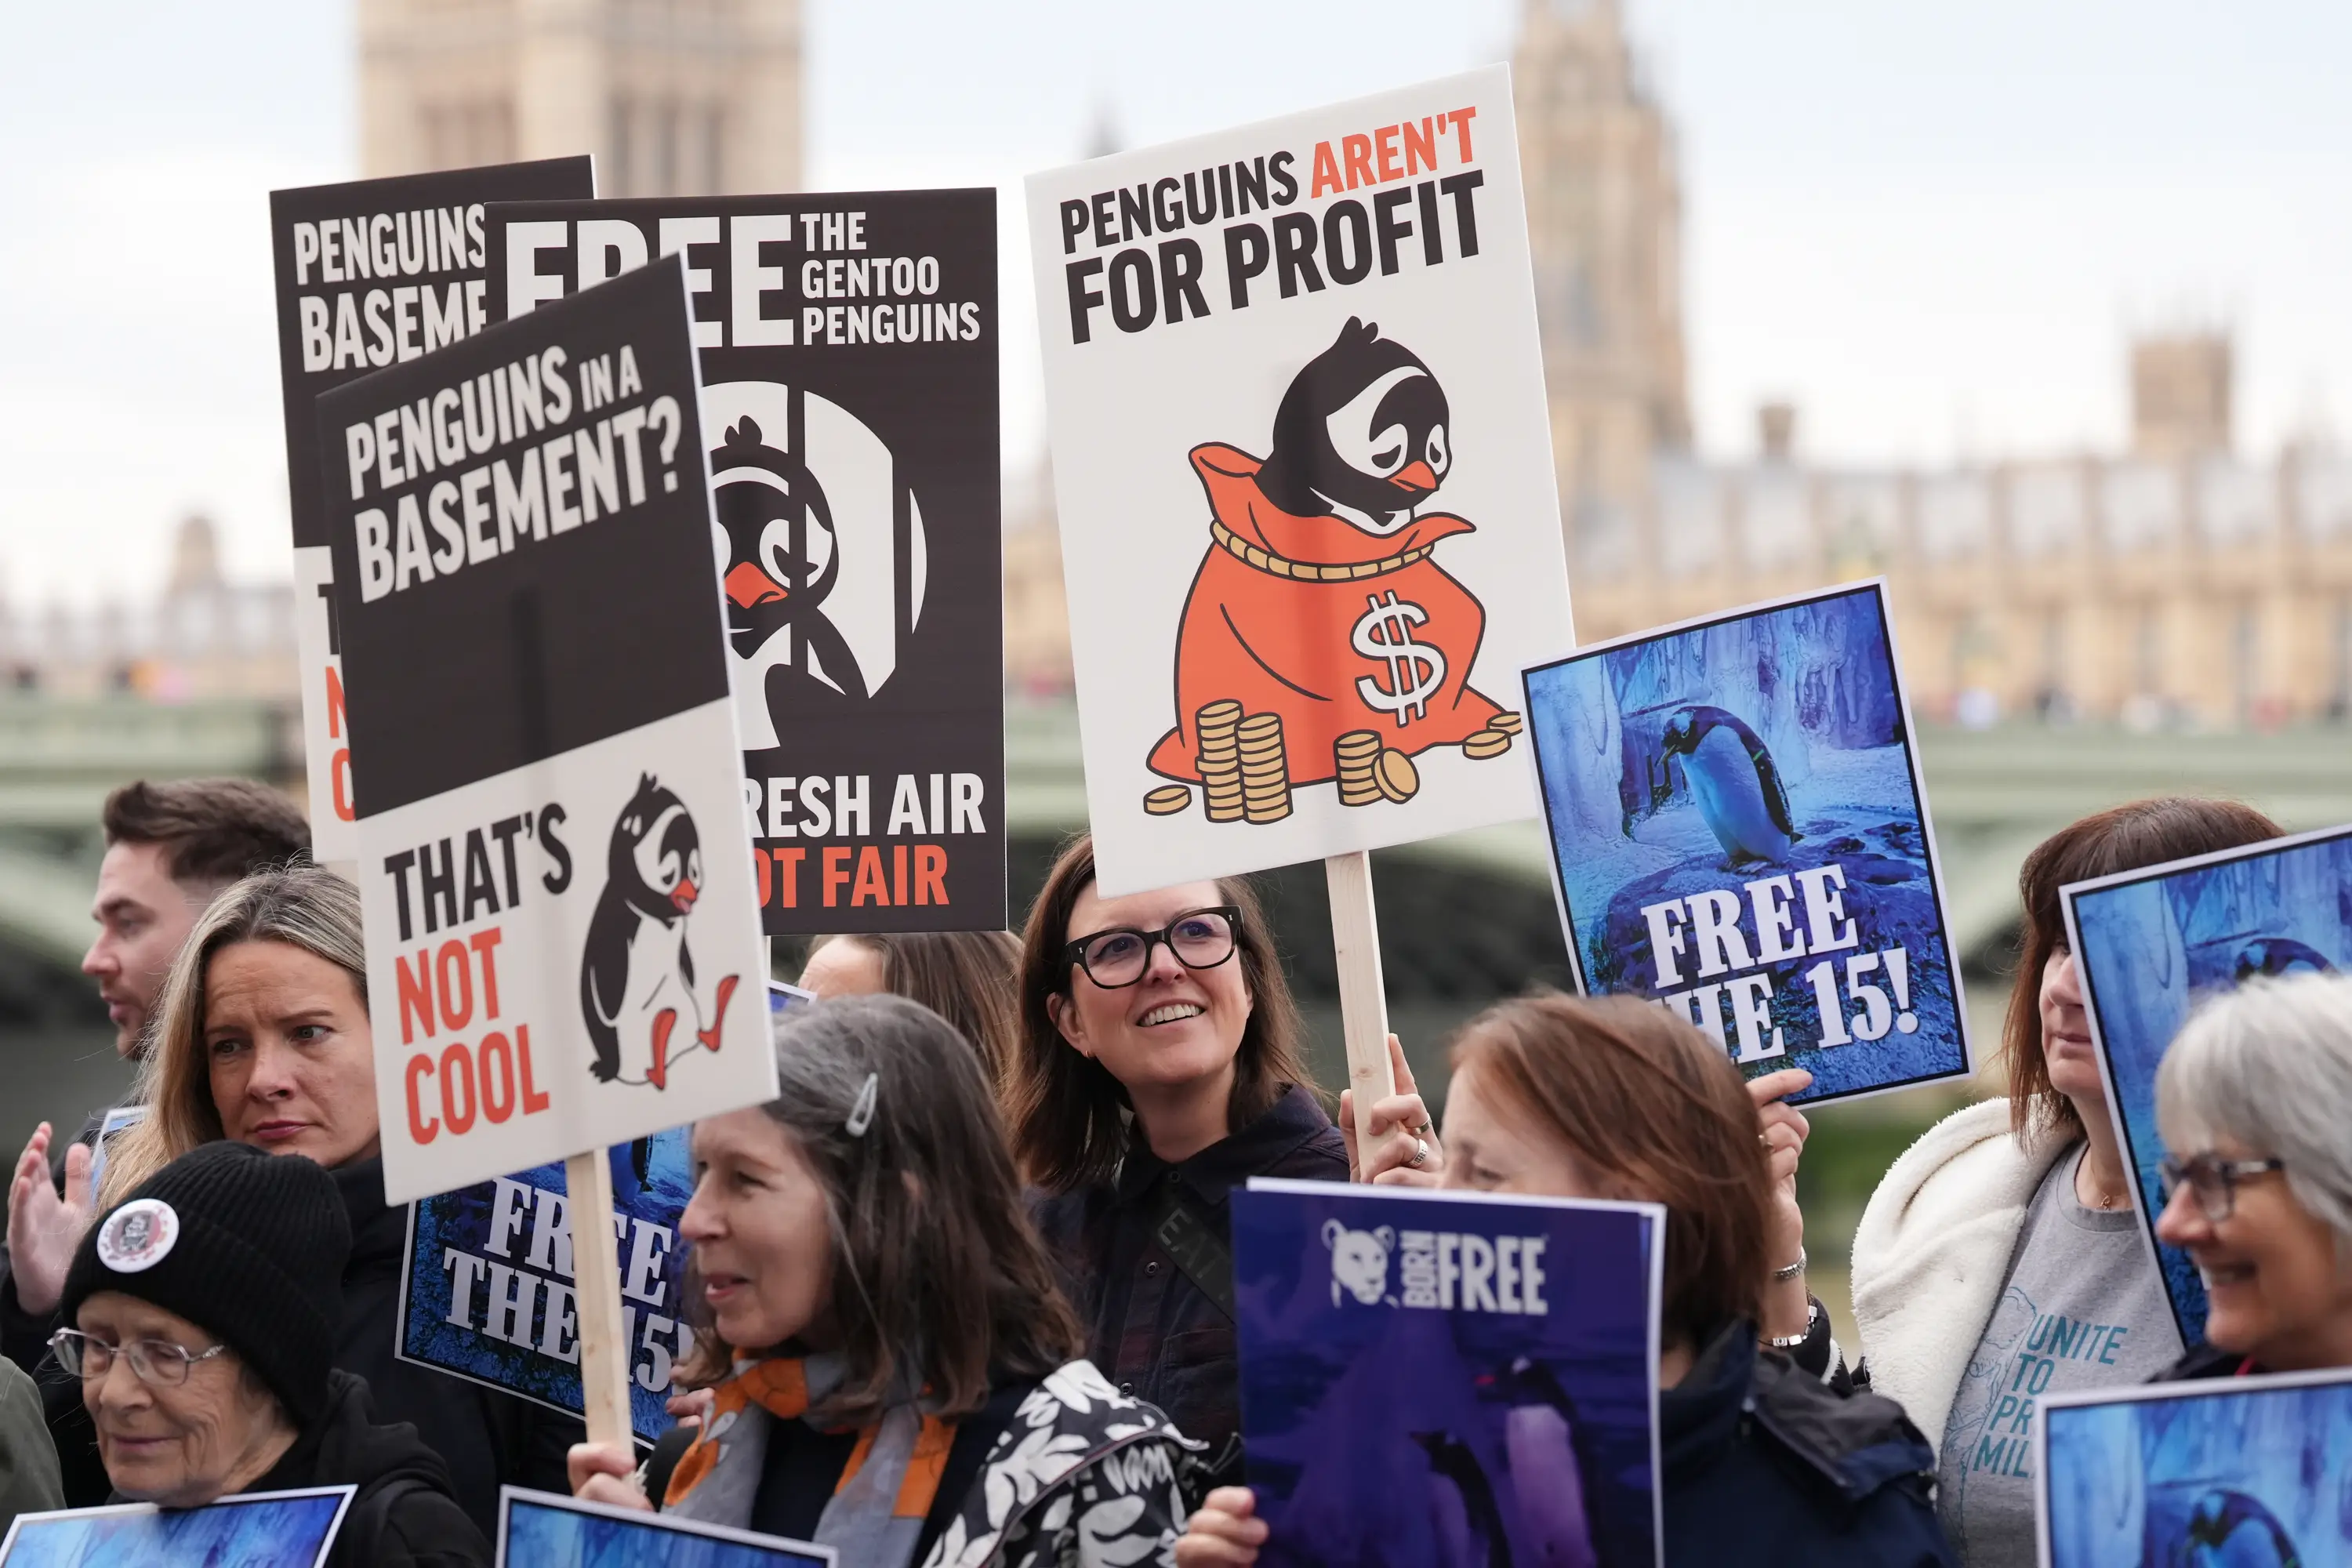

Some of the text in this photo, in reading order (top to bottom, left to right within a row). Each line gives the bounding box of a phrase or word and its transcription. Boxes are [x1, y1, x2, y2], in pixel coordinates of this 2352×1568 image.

[800, 212, 867, 252] THE
[1060, 106, 1477, 254] PENGUINS AREN'T
[293, 204, 485, 285] PENGUINS
[801, 256, 939, 299] GENTOO
[1065, 169, 1484, 345] FOR PROFIT
[803, 302, 981, 345] PENGUINS
[345, 344, 643, 500] PENGUINS IN A
[354, 395, 681, 604] BASEMENT?
[887, 773, 987, 835] AIR
[384, 802, 573, 942] THAT'S
[823, 844, 949, 907] FAIR
[1640, 863, 1859, 989] FREE
[395, 927, 502, 1045] NOT
[1648, 947, 1918, 1065] HE 15!
[405, 1024, 550, 1145] COOL
[484, 1176, 672, 1307] FRE
[1437, 1232, 1548, 1316] FREE
[443, 1247, 579, 1365] THE
[2026, 1314, 2129, 1366] UNITE
[2011, 1352, 2056, 1396] TO
